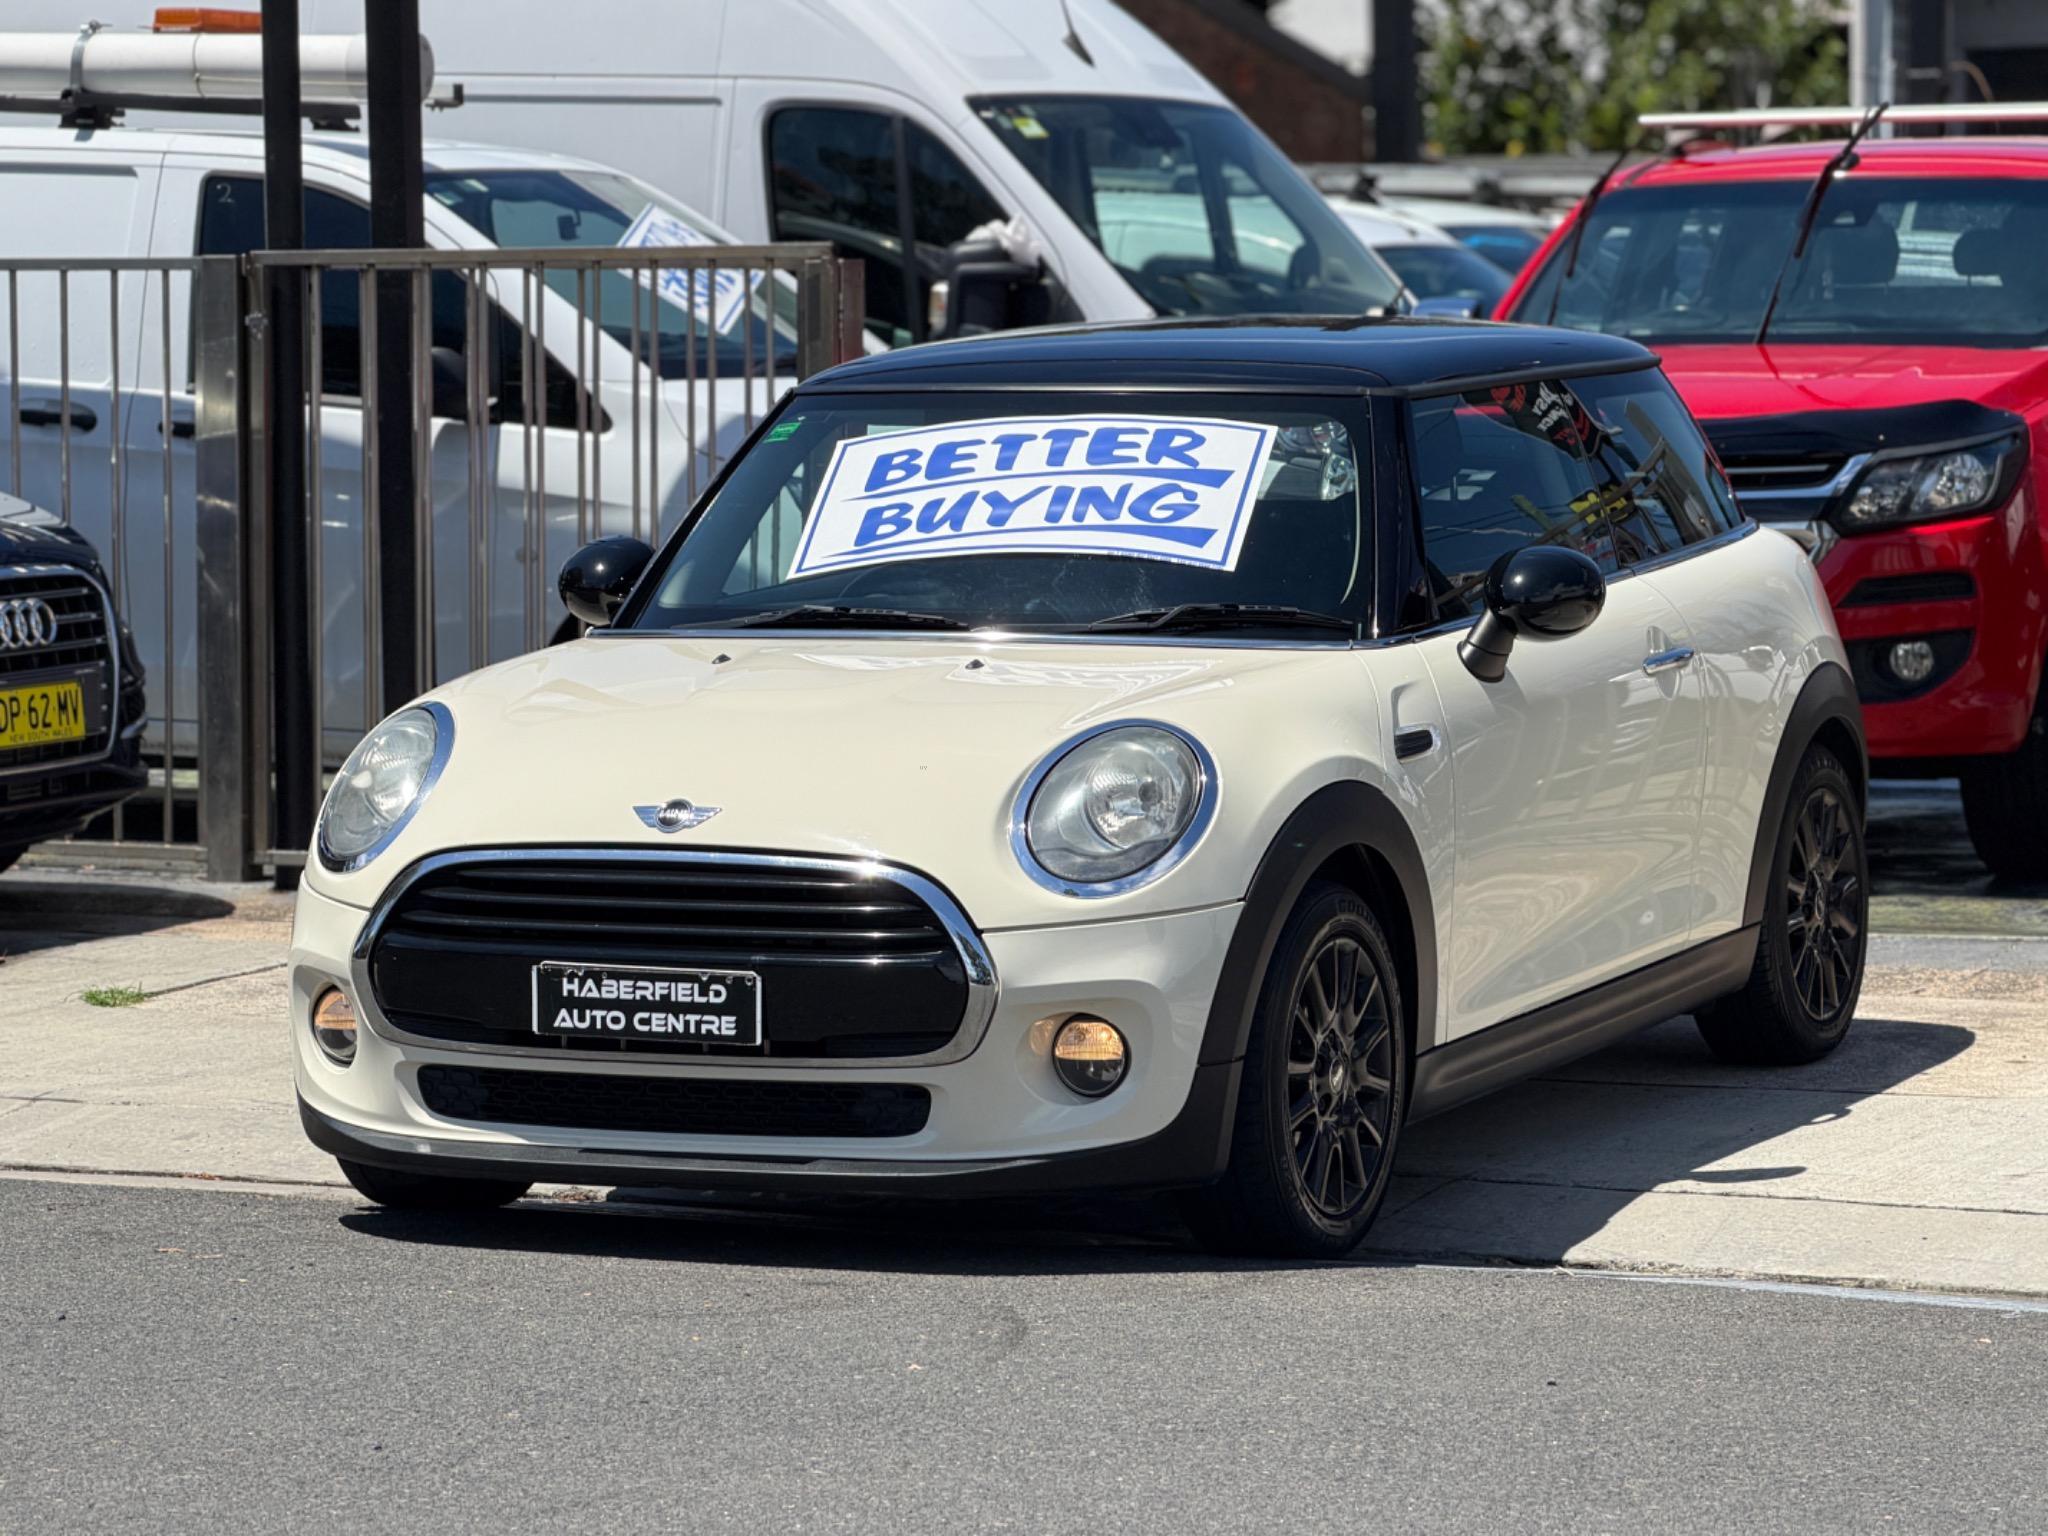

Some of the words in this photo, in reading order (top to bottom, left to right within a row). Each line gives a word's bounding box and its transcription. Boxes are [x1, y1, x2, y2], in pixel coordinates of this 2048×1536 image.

[864, 427, 1207, 493] BETTER
[854, 482, 1201, 547] BUYING
[28, 693, 52, 729] 62
[57, 689, 79, 727] MV
[562, 978, 728, 1003] HABERFIELD
[553, 1008, 627, 1031] AUTO
[633, 1011, 737, 1036] CENTRE
